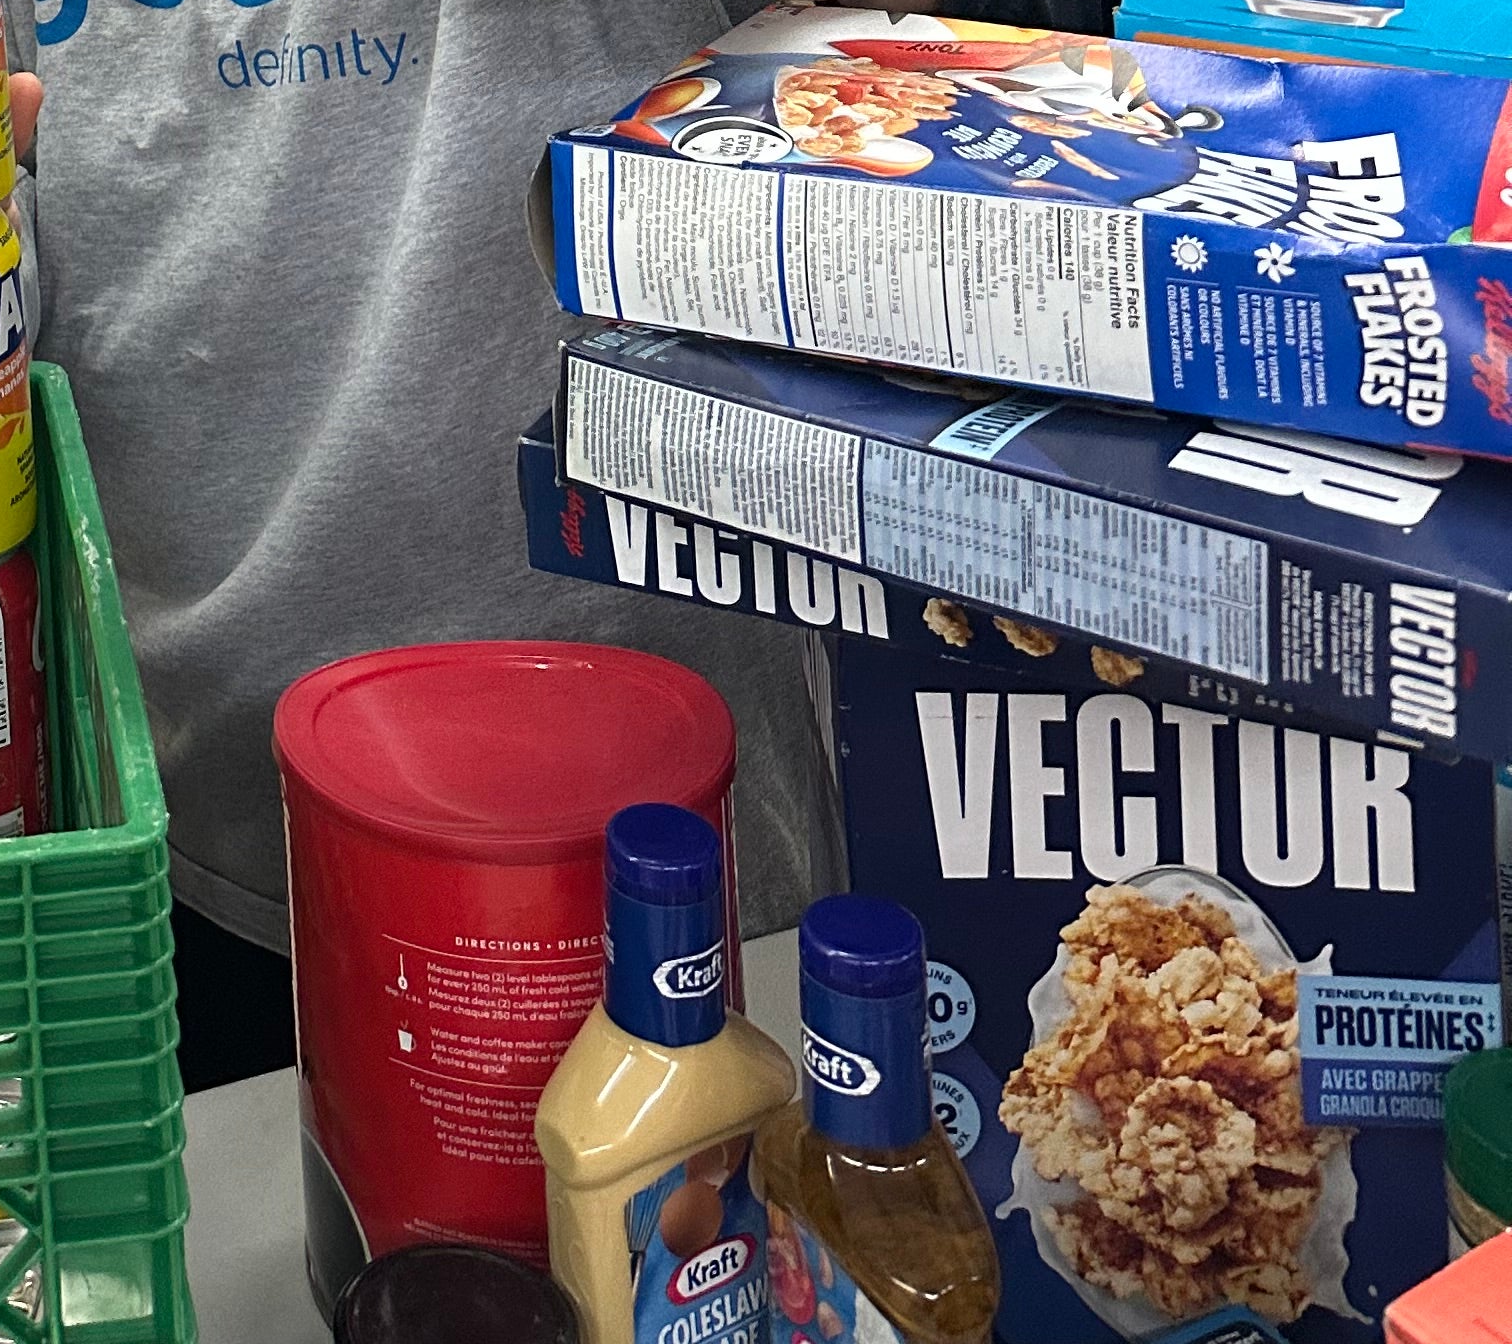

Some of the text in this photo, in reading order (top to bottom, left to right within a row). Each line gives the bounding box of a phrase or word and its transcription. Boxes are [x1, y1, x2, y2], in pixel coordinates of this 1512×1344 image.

[905, 43, 965, 54] TONY
[1063, 208, 1074, 280] Calories 140
[1107, 214, 1122, 328] Valeur nutritive
[1124, 215, 1140, 328] Nutrition Facts
[1198, 303, 1209, 343] COLOURS
[1238, 293, 1248, 335] VITAMINE
[1283, 298, 1294, 335] VITAMIN
[1167, 285, 1183, 388] COLORANTS ARTIFICIELS
[1212, 306, 1228, 399] ARTIFICIAL FLAVOURS
[1265, 296, 1281, 403] SOURCE VITAMINES
[1310, 301, 1326, 405] SOURCE VITAMINS
[1345, 272, 1400, 410] FLAKES
[1384, 256, 1448, 428] FROSTED
[1390, 583, 1457, 739] VECTOR
[915, 691, 1415, 893] VECTOR
[455, 936, 540, 952] DIRECTIONS
[427, 962, 591, 984] Measure level tablespoons
[443, 978, 575, 995] every fresh cold
[677, 953, 723, 989] Kraft
[1314, 988, 1483, 1005] TENEUR ÉLEVÉE EN
[430, 1027, 546, 1049] Water and coffee maker
[1315, 1003, 1485, 1052] PROTÉINES
[802, 1035, 853, 1085] Kraft
[1322, 1069, 1444, 1093] AVEC GRAPPE
[427, 1086, 464, 1102] optimal
[1320, 1094, 1387, 1116] GRANOLA
[434, 1116, 457, 1130] Pour
[688, 1247, 738, 1291] Kraft
